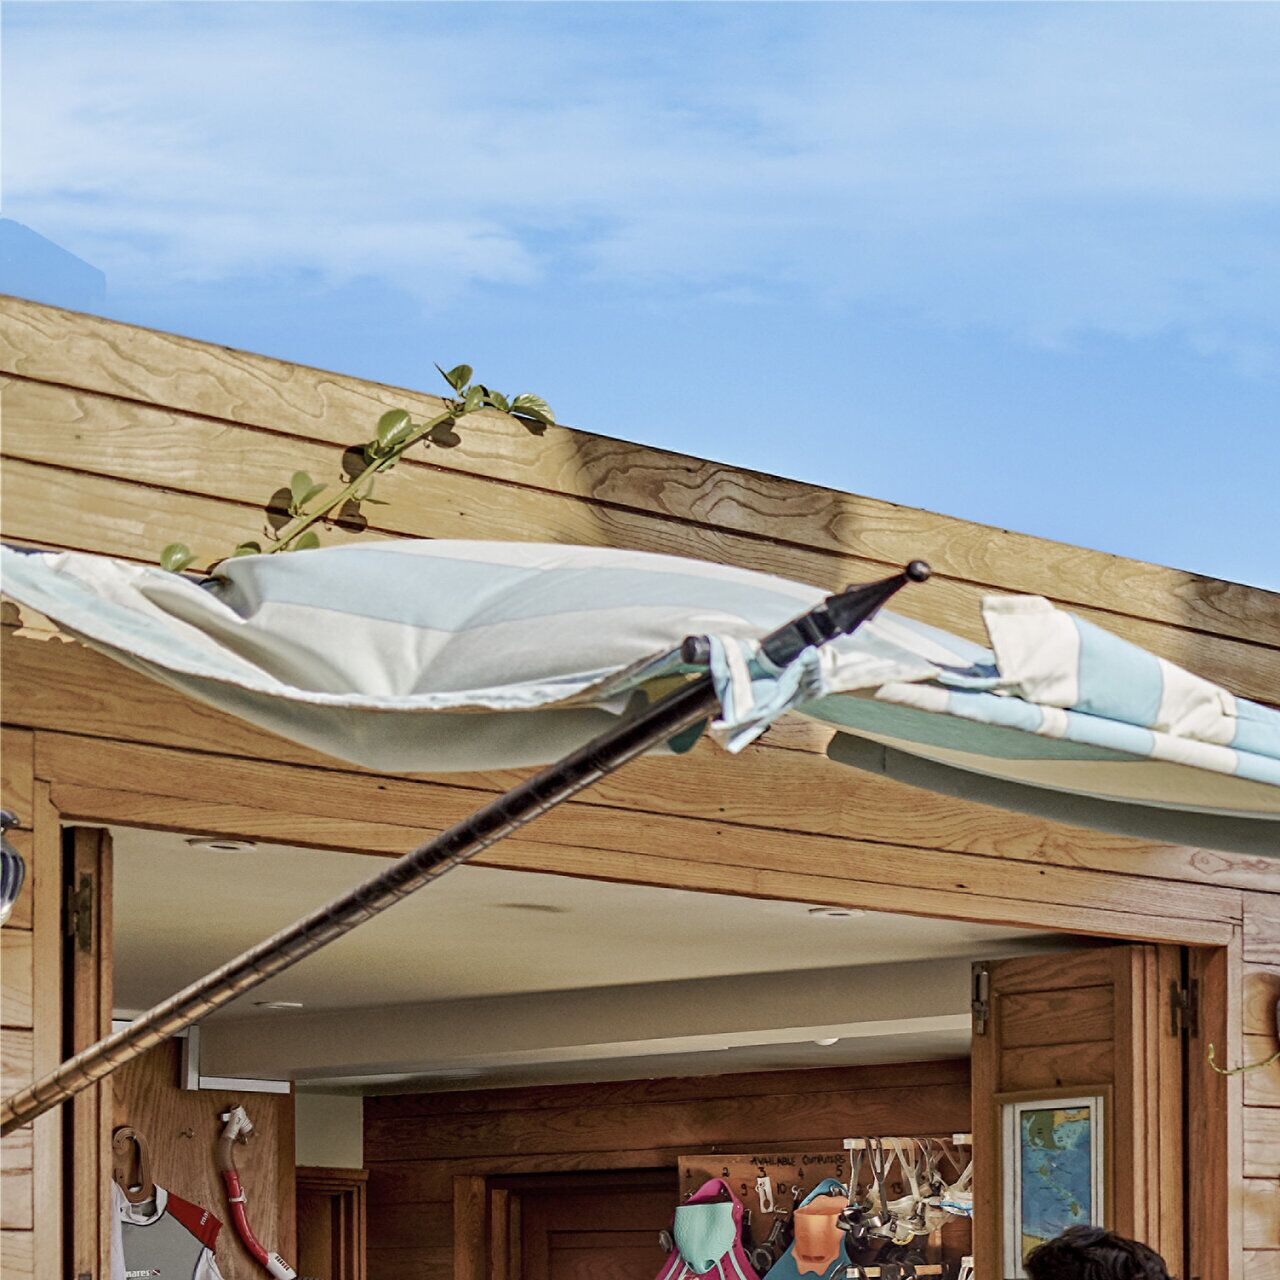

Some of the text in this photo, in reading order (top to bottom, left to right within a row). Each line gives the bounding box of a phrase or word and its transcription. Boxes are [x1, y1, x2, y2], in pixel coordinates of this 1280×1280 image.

[751, 1156, 796, 1166] AVAILABLE
[722, 1167, 730, 1178] 2
[757, 1167, 766, 1178] 3
[836, 1165, 843, 1177] 5
[741, 1184, 748, 1196] 9
[776, 1182, 787, 1194] 10
